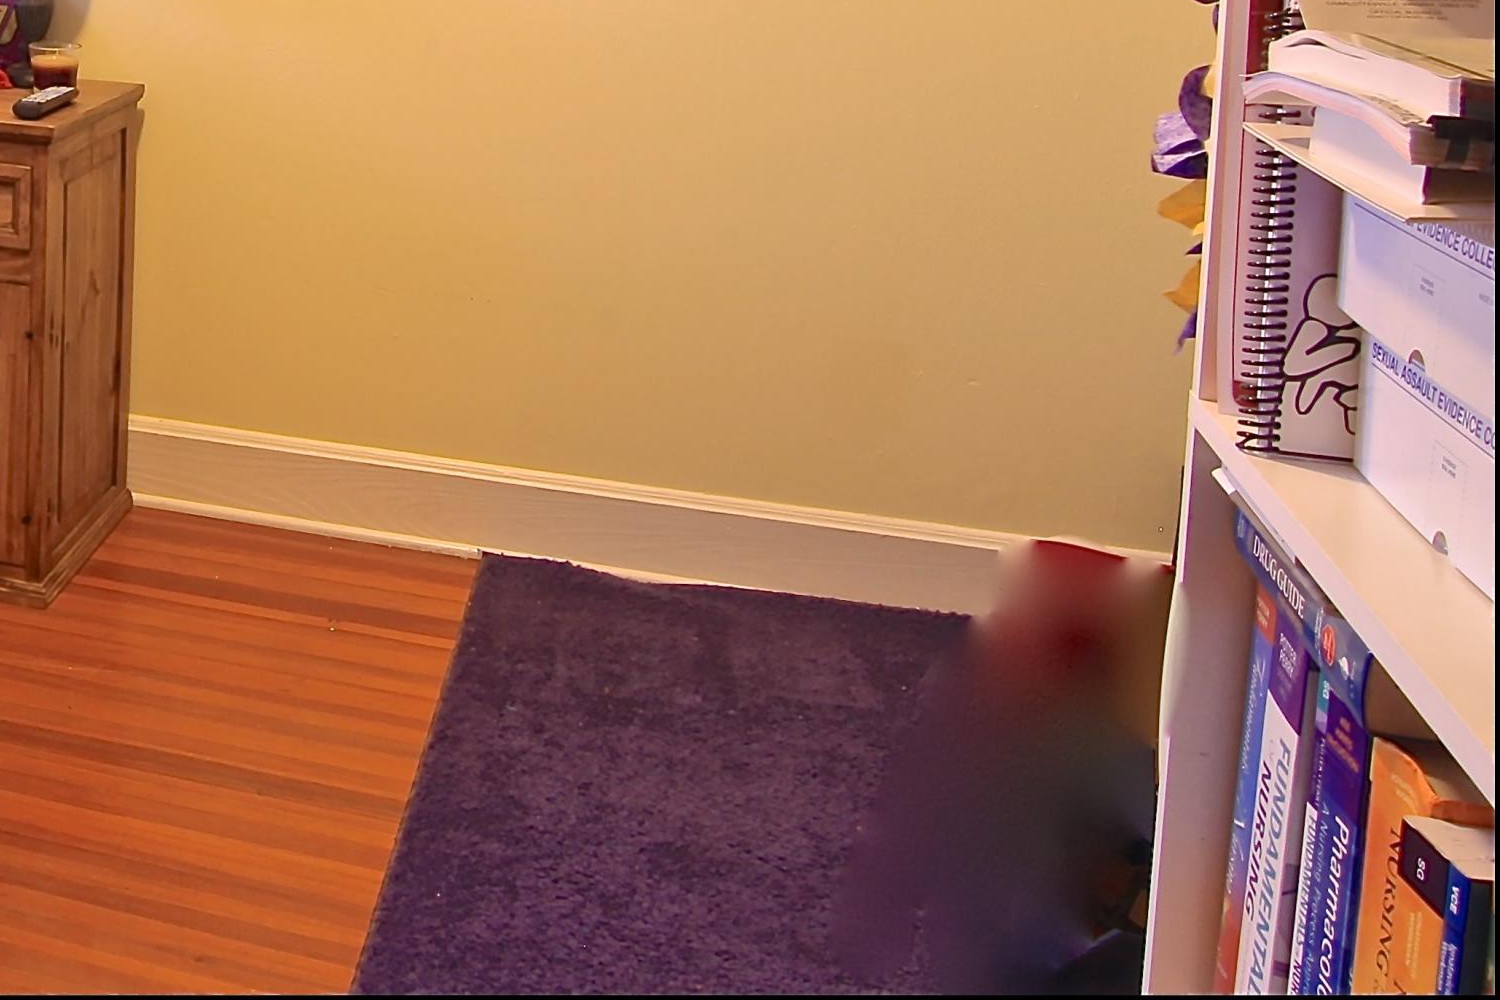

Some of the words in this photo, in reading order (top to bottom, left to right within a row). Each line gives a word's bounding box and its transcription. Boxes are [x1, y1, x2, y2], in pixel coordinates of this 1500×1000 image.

[1461, 237, 1495, 272] COLLE
[1372, 342, 1399, 376] SEXUAL
[1400, 365, 1438, 403] ASSAULT
[1438, 391, 1484, 439] EVIDENCE
[1252, 535, 1277, 583] DRUG
[1277, 567, 1306, 620] GUIDE
[1243, 759, 1272, 923] NURSING
[1314, 819, 1329, 882] Nursing
[1416, 856, 1427, 882] SG
[1309, 886, 1322, 947] Process
[1449, 885, 1461, 915] VCE
